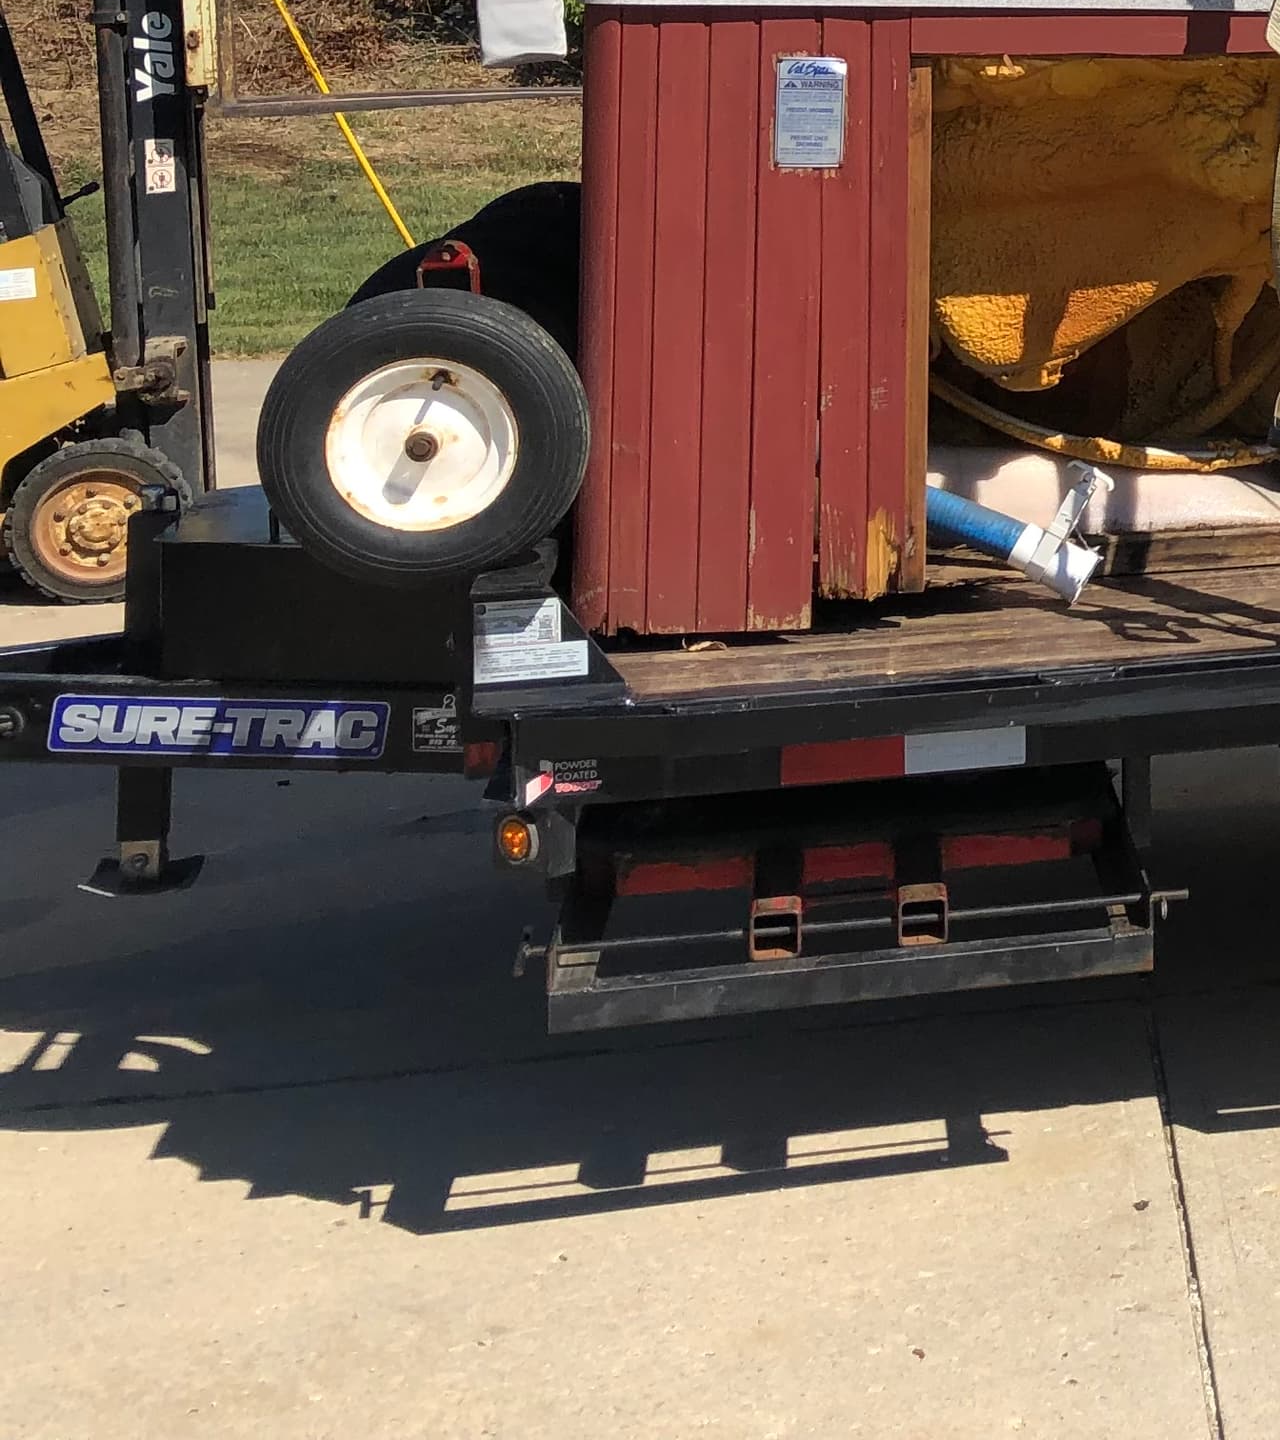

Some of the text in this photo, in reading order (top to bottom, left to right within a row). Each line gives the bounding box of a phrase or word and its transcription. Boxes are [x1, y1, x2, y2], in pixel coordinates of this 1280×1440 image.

[133, 11, 175, 102] Yale
[800, 80, 840, 89] WARNING
[58, 703, 380, 751] SURE-TRAC
[554, 759, 598, 771] POWDER
[555, 770, 598, 782] COATED
